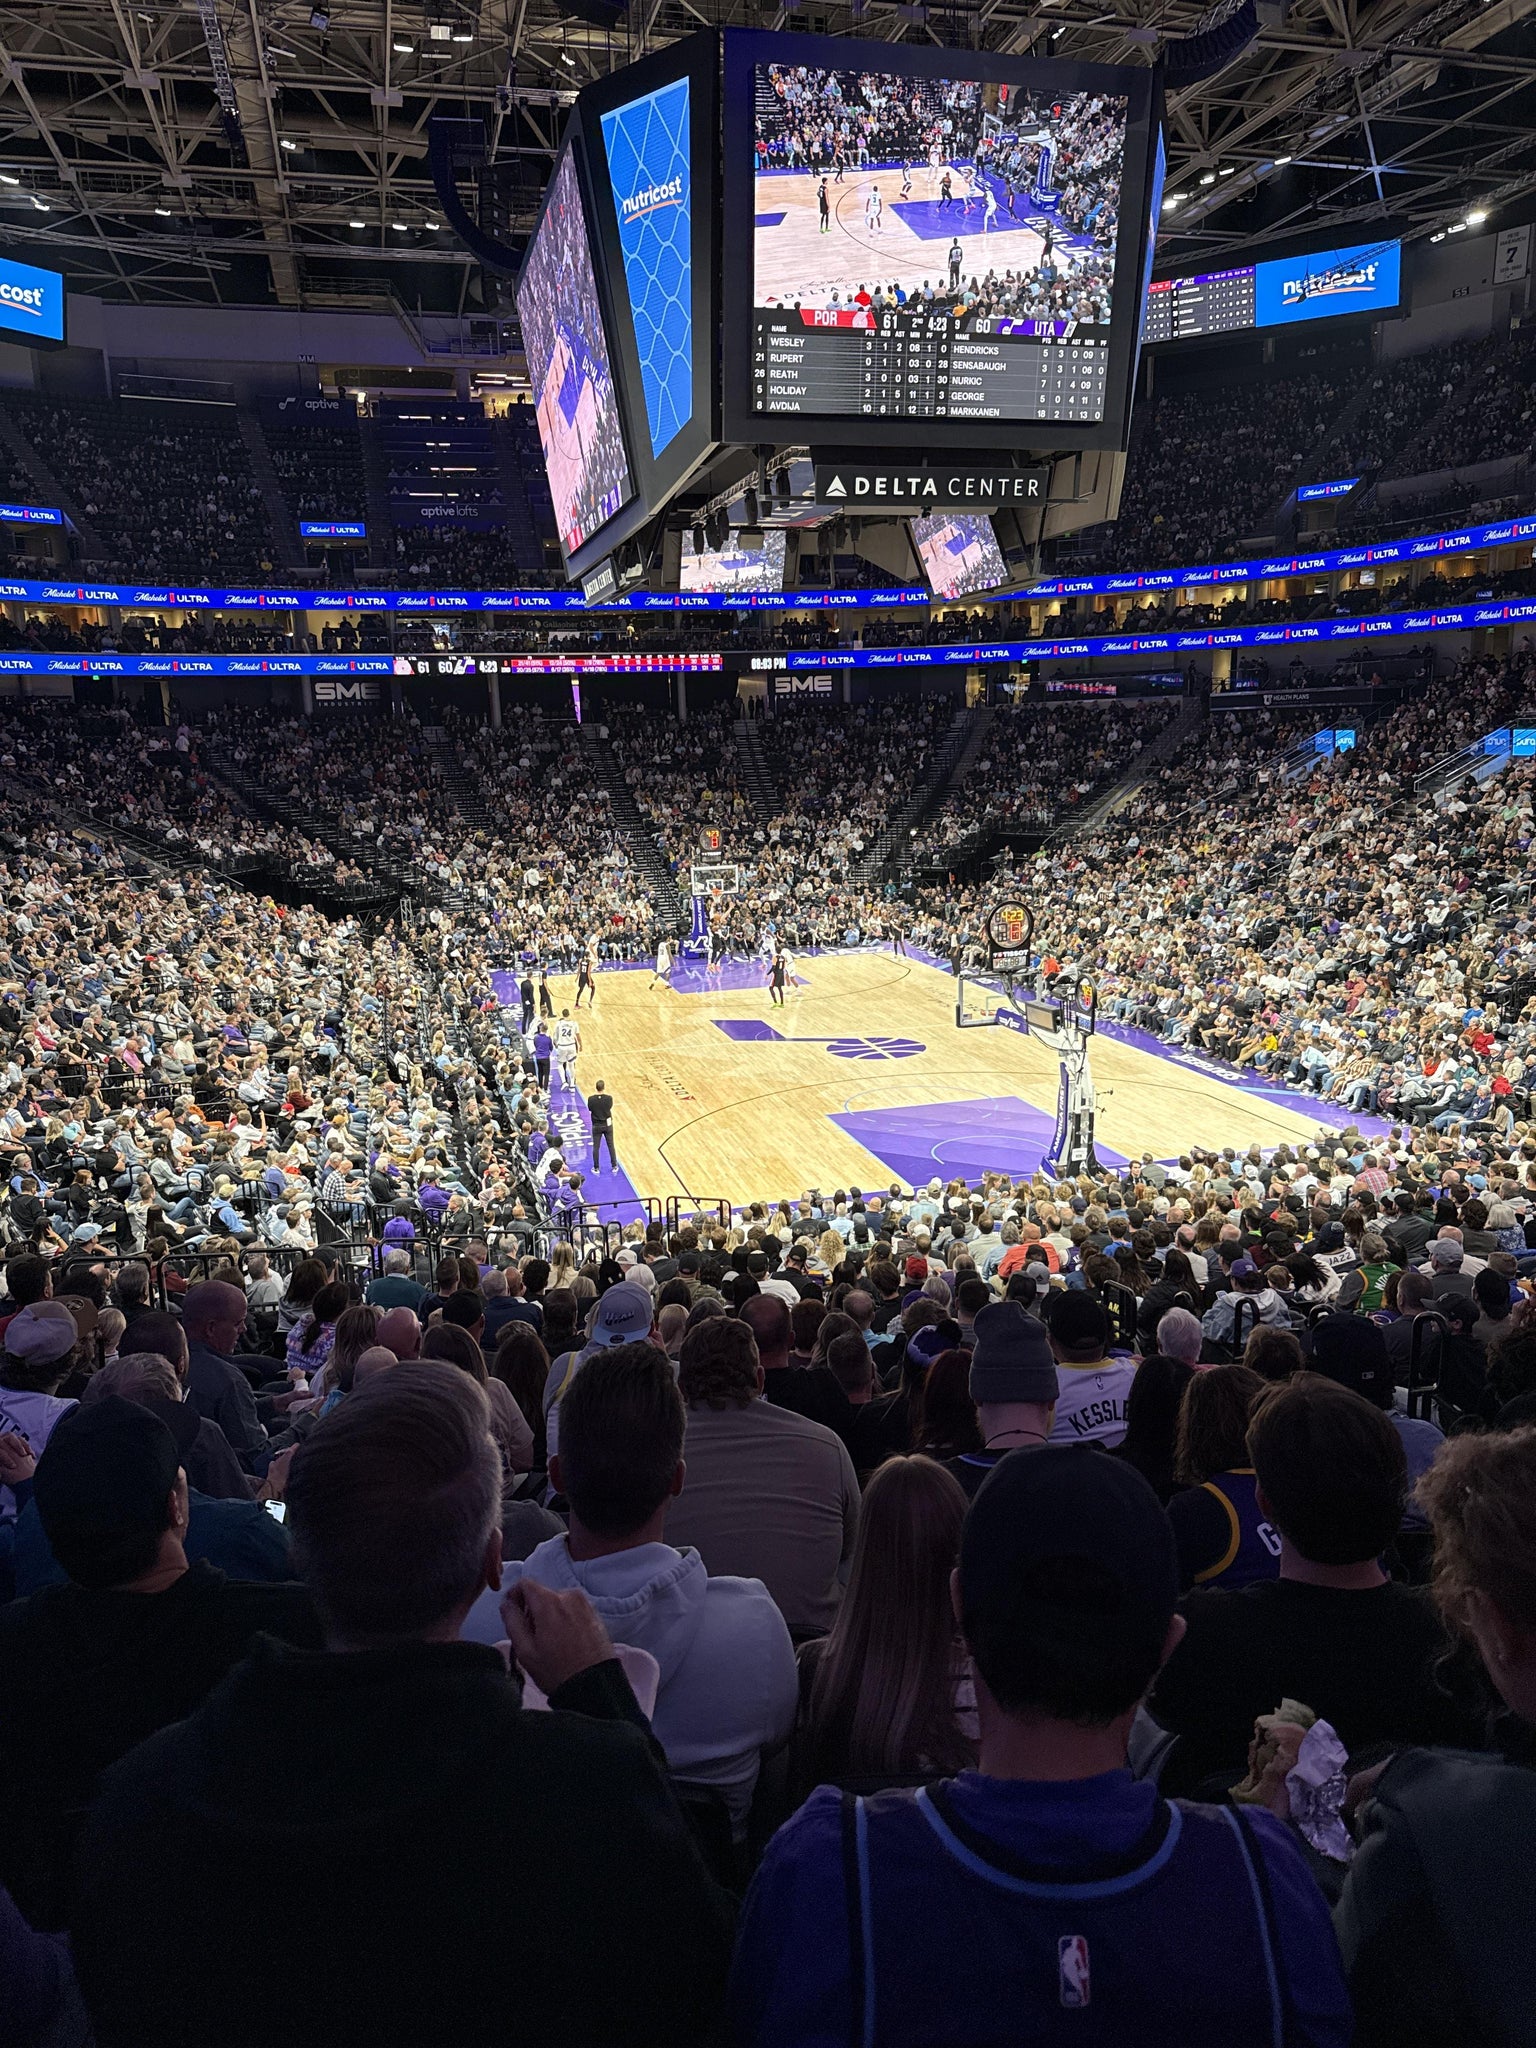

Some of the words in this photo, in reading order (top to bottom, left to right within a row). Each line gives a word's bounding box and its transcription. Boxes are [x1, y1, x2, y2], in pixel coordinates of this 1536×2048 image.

[622, 175, 682, 214] nutricost
[1507, 247, 1518, 263] 7
[815, 311, 837, 325] POR
[883, 315, 897, 329] 61
[928, 317, 947, 331] 4:23
[955, 320, 960, 329] 9
[976, 319, 990, 333] 60
[1035, 321, 1055, 336] UTA
[758, 337, 762, 345] 1
[770, 338, 805, 347] WESLEY
[866, 342, 872, 350] 3
[897, 343, 902, 351] 2
[909, 344, 920, 352] 08
[941, 345, 946, 353] 0
[954, 346, 999, 355] HENDRICKS
[1043, 349, 1048, 357] 5
[1058, 350, 1064, 358] 3
[1072, 350, 1078, 358] 0
[1083, 351, 1093, 359] 09
[756, 353, 764, 361] 21
[770, 354, 804, 363] RUPERT
[909, 359, 919, 367] 03
[938, 360, 948, 368] 28
[953, 362, 1006, 371] SENSABAUGH
[755, 369, 765, 377] 26
[770, 370, 798, 378] REATH
[908, 375, 918, 383] 03
[937, 376, 947, 384] 30
[952, 377, 982, 385] NURKIC
[757, 385, 762, 393] 5
[770, 386, 807, 395] HOLIDAY
[939, 392, 944, 400] 3
[951, 392, 984, 401] GEORGE
[305, 399, 339, 411] aptive
[756, 401, 762, 409] 8
[770, 402, 800, 410] AVDIJA
[863, 405, 871, 413] 10
[908, 406, 916, 414] 12
[936, 407, 946, 415] 23
[951, 408, 1000, 416] MARKKANEN
[855, 477, 938, 496] DELTA
[948, 478, 1039, 497] CENTER
[30, 511, 56, 520] ULTRA
[421, 507, 455, 518] aptive
[456, 505, 478, 516] lofts
[1411, 543, 1439, 554] Michelob
[1445, 537, 1470, 547] ULTRA
[1338, 554, 1366, 564] Michelob
[1373, 549, 1399, 559] ULTRA
[1261, 563, 1291, 574] Michelob
[1298, 560, 1325, 569] ULTRA
[1182, 572, 1212, 582] Michelob
[1220, 568, 1248, 577] ULTRA
[1028, 584, 1057, 594] Michelob
[1064, 582, 1093, 592] ULTRA
[1107, 577, 1136, 588] Michelob
[1144, 576, 1173, 586] ULTRA
[42, 588, 75, 598] Michelob
[86, 591, 118, 600] ULTRA
[134, 592, 167, 602] Michelob
[177, 595, 209, 604] ULTRA
[224, 595, 257, 604] Michelob
[267, 597, 299, 605] ULTRA
[830, 596, 857, 604] ULTRA
[314, 597, 346, 606] Michelob
[355, 598, 386, 606] ULTRA
[397, 597, 428, 606] Michelob
[482, 597, 512, 606] Michelob
[681, 597, 709, 605] ULTRA
[758, 597, 785, 605] ULTRA
[1510, 606, 1536, 616] ULTRA
[1403, 618, 1430, 628] Michelob
[1437, 615, 1462, 625] ULTRA
[1331, 625, 1360, 635] Michelob
[1367, 622, 1392, 632] ULTRA
[1177, 636, 1206, 646] Michelob
[1214, 635, 1242, 643] ULTRA
[1255, 631, 1284, 641] Michelob
[1291, 629, 1318, 638] ULTRA
[1022, 647, 1051, 656] Michelob
[1060, 645, 1088, 654] ULTRA
[1102, 641, 1131, 651] Michelob
[1140, 640, 1168, 649] ULTRA
[868, 654, 895, 663] Michelob
[904, 654, 931, 662] ULTRA
[945, 651, 972, 660] Michelob
[981, 649, 1009, 658] ULTRA
[0, 660, 33, 669] ULTRA
[48, 660, 80, 670] Michelob
[90, 662, 123, 671] ULTRA
[138, 662, 170, 671] Michelob
[180, 663, 212, 671] ULTRA
[228, 662, 260, 671] Michelob
[316, 662, 348, 670] Michelob
[418, 661, 429, 673] 61
[438, 661, 452, 673] 60
[479, 661, 497, 673] 4:23
[774, 658, 786, 669] PM
[793, 656, 820, 666] Michelob
[828, 656, 855, 664] ULTRA
[775, 675, 832, 693] SME
[315, 683, 380, 700] SME
[1002, 908, 1024, 922] 4:23
[562, 1029, 571, 1037] 24
[1053, 1113, 1063, 1153] AMERICA
[1329, 1252, 1352, 1266] JAZZ
